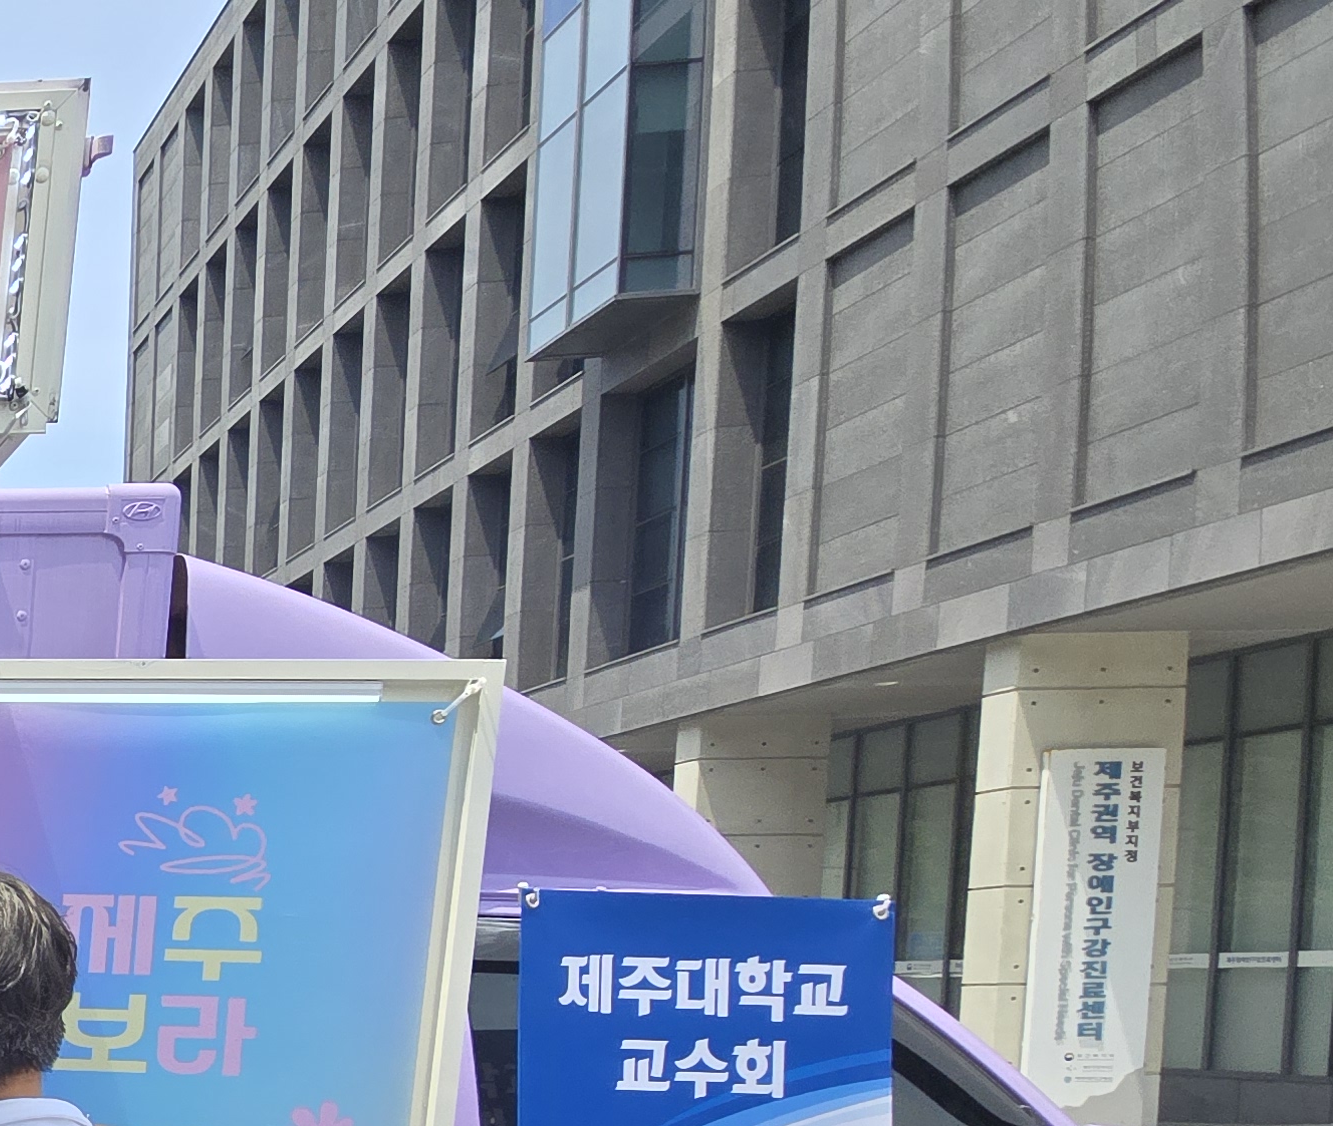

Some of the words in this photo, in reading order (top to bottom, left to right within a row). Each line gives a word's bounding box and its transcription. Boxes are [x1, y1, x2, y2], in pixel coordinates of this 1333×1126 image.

[1088, 761, 1122, 844] 제주권역
[1124, 761, 1144, 863] 보건복지부지정
[1077, 852, 1118, 1041] 장애인구강진료센터
[559, 955, 848, 1022] 제주대학교
[615, 1037, 786, 1100] 교수회
